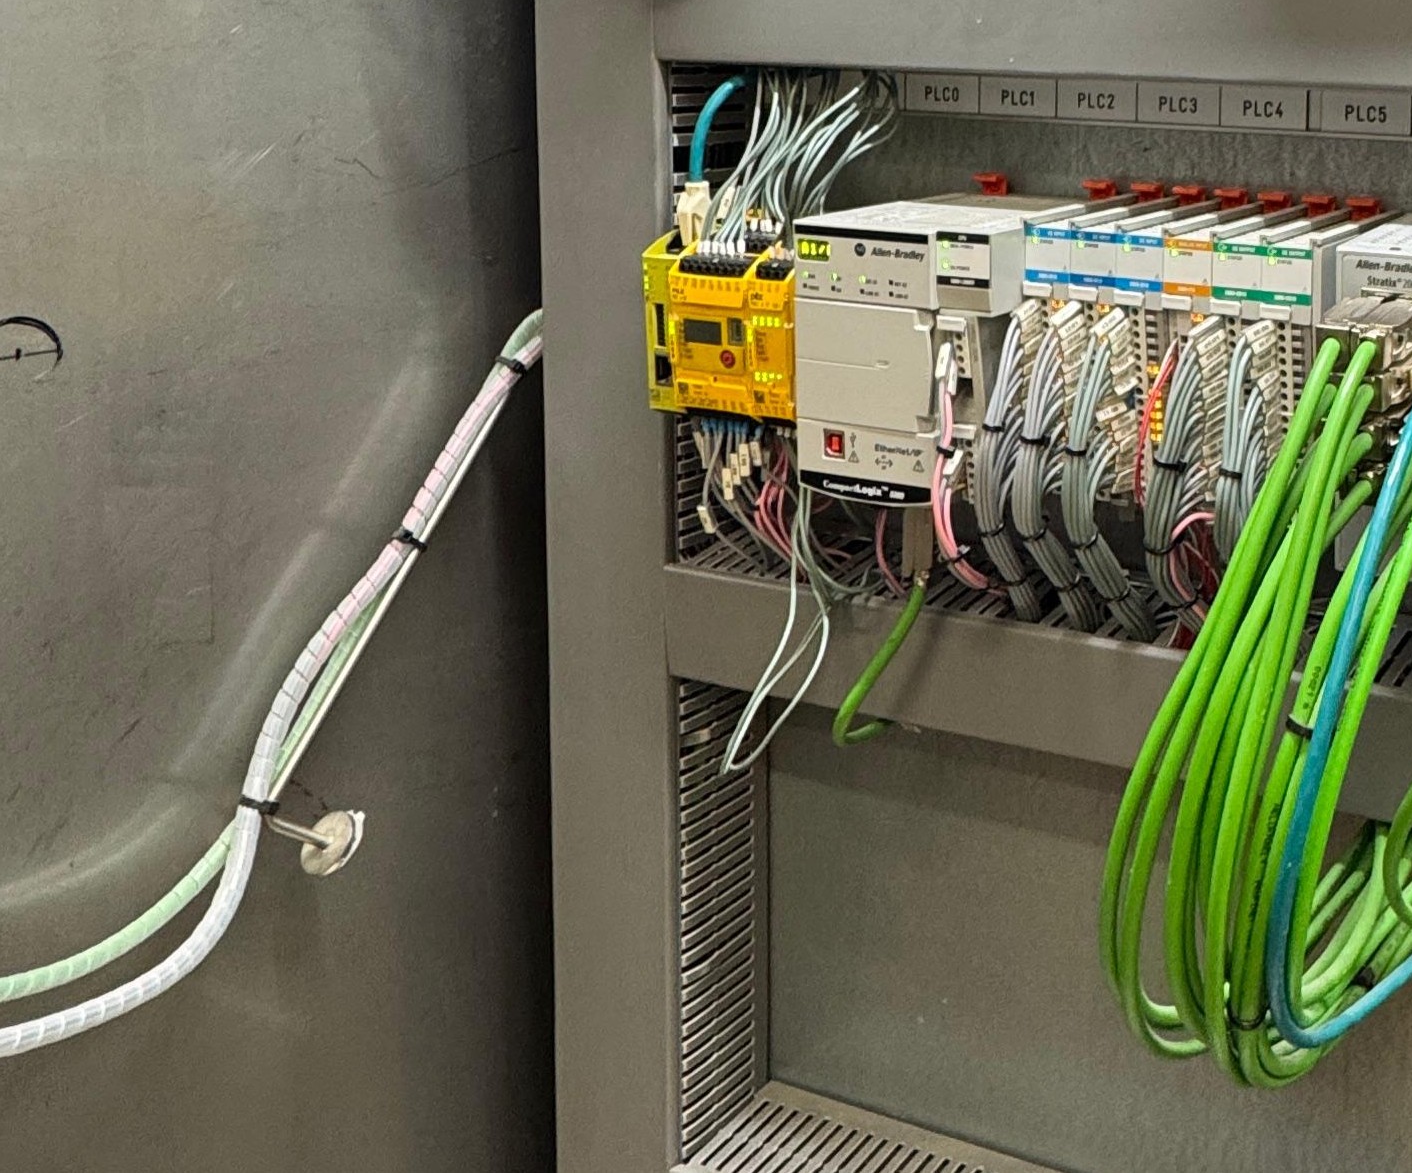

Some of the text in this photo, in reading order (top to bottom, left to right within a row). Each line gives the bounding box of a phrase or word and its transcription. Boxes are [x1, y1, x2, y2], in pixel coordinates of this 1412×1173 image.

[924, 85, 960, 103] PLC0
[1000, 89, 1035, 107] PLC1
[1077, 92, 1116, 110] PLC2
[1158, 95, 1198, 114] PLC3
[1242, 99, 1284, 119] PLC4
[1344, 104, 1388, 124] PLC5
[871, 247, 925, 262] Allen-Bradley
